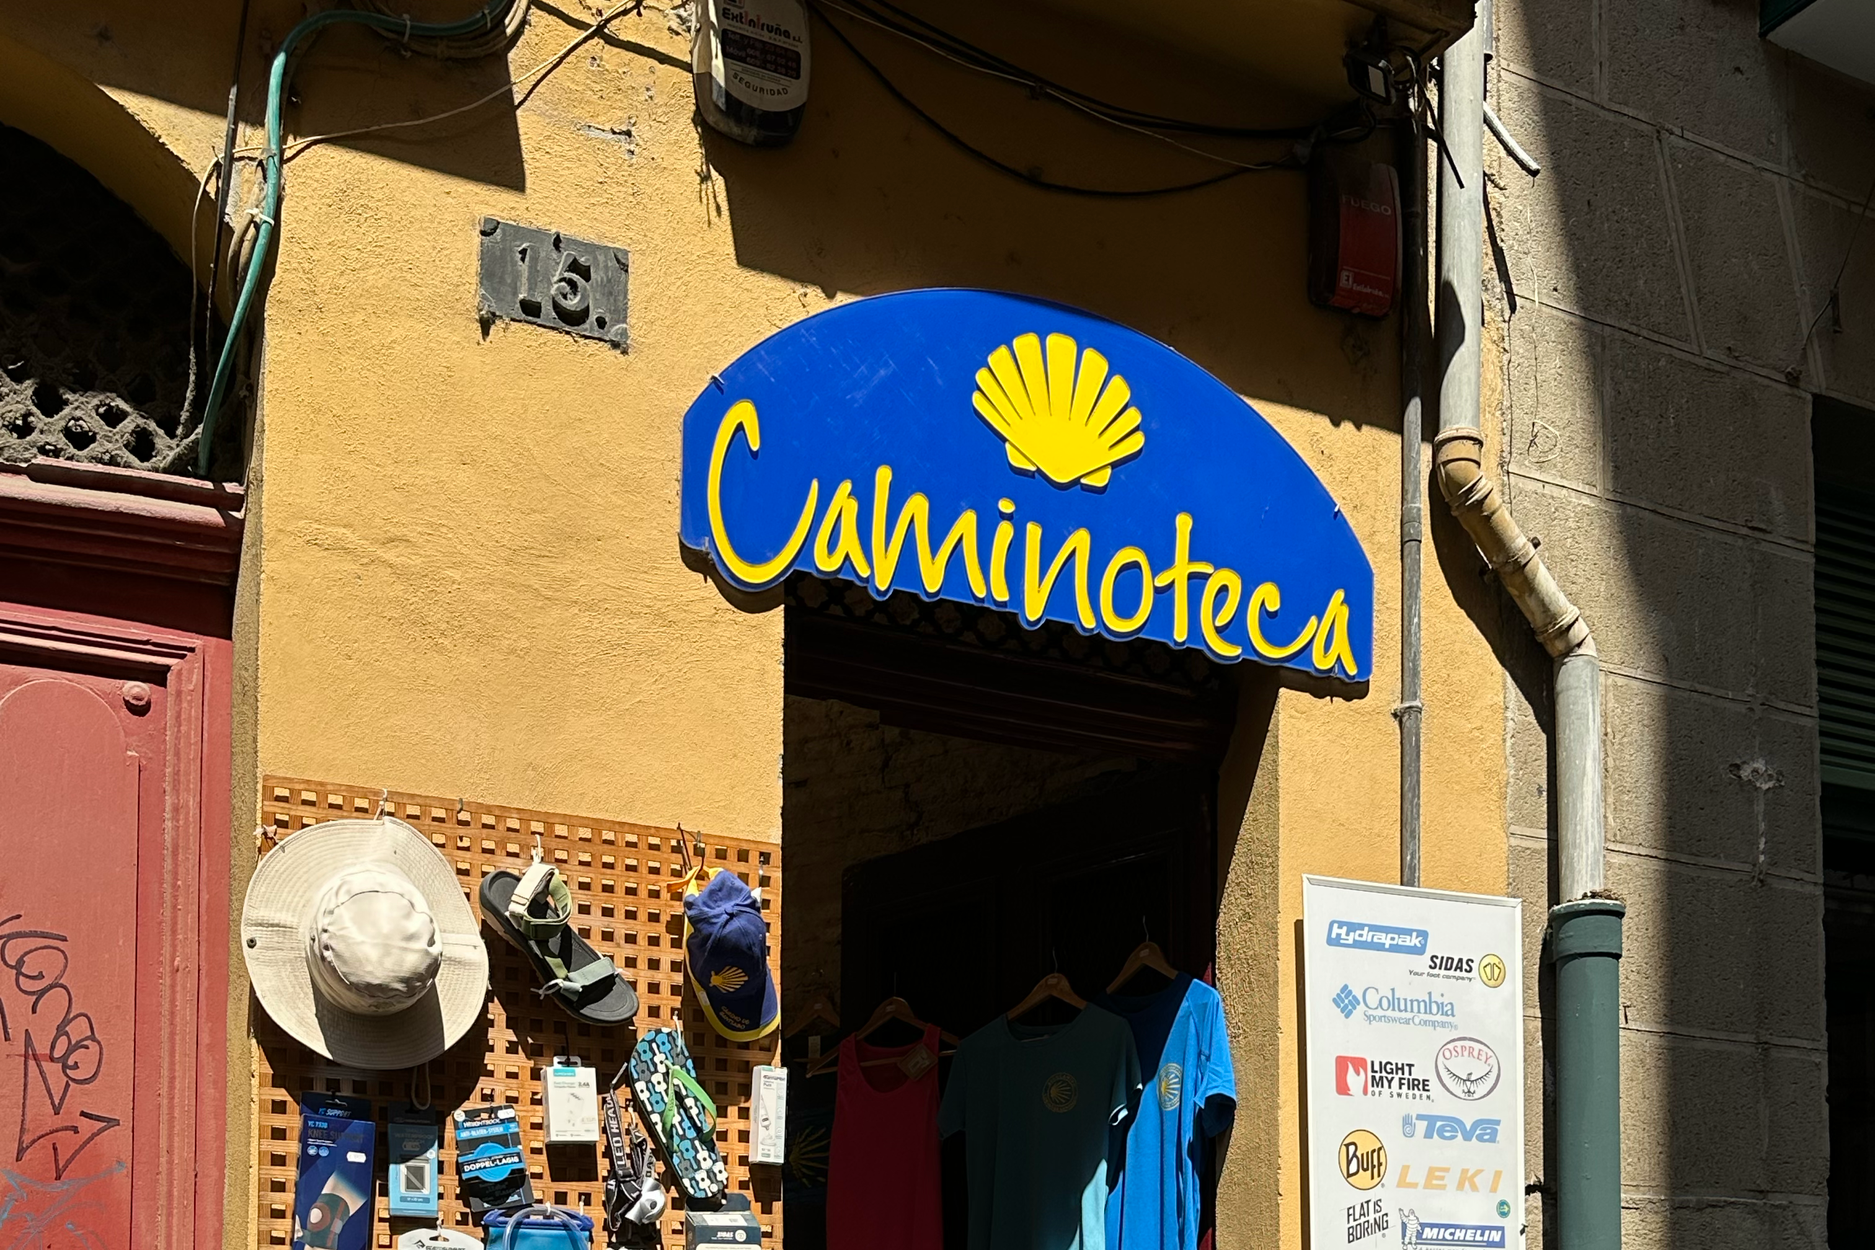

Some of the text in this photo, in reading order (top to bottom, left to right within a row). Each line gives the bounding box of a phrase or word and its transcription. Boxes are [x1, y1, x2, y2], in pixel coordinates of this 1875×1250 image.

[732, 72, 788, 96] SEGURIDAD
[1341, 195, 1392, 215] FUEGO
[707, 398, 1358, 676] Caminoteca
[1331, 923, 1424, 948] Hydrapak
[1428, 954, 1474, 973] SIDAS
[1362, 986, 1456, 1018] Columbia
[1442, 1044, 1493, 1065] OSPREY
[1370, 1060, 1415, 1076] LIGHT
[1370, 1075, 1431, 1092] MY FIRE
[1390, 1091, 1431, 1101] SWEDEN
[307, 1128, 329, 1139] KNEE
[614, 1139, 626, 1166] LED
[1396, 1164, 1503, 1193] LEKI
[1347, 1198, 1383, 1225] FLAT IS
[1422, 1227, 1502, 1242] MICHELIN
